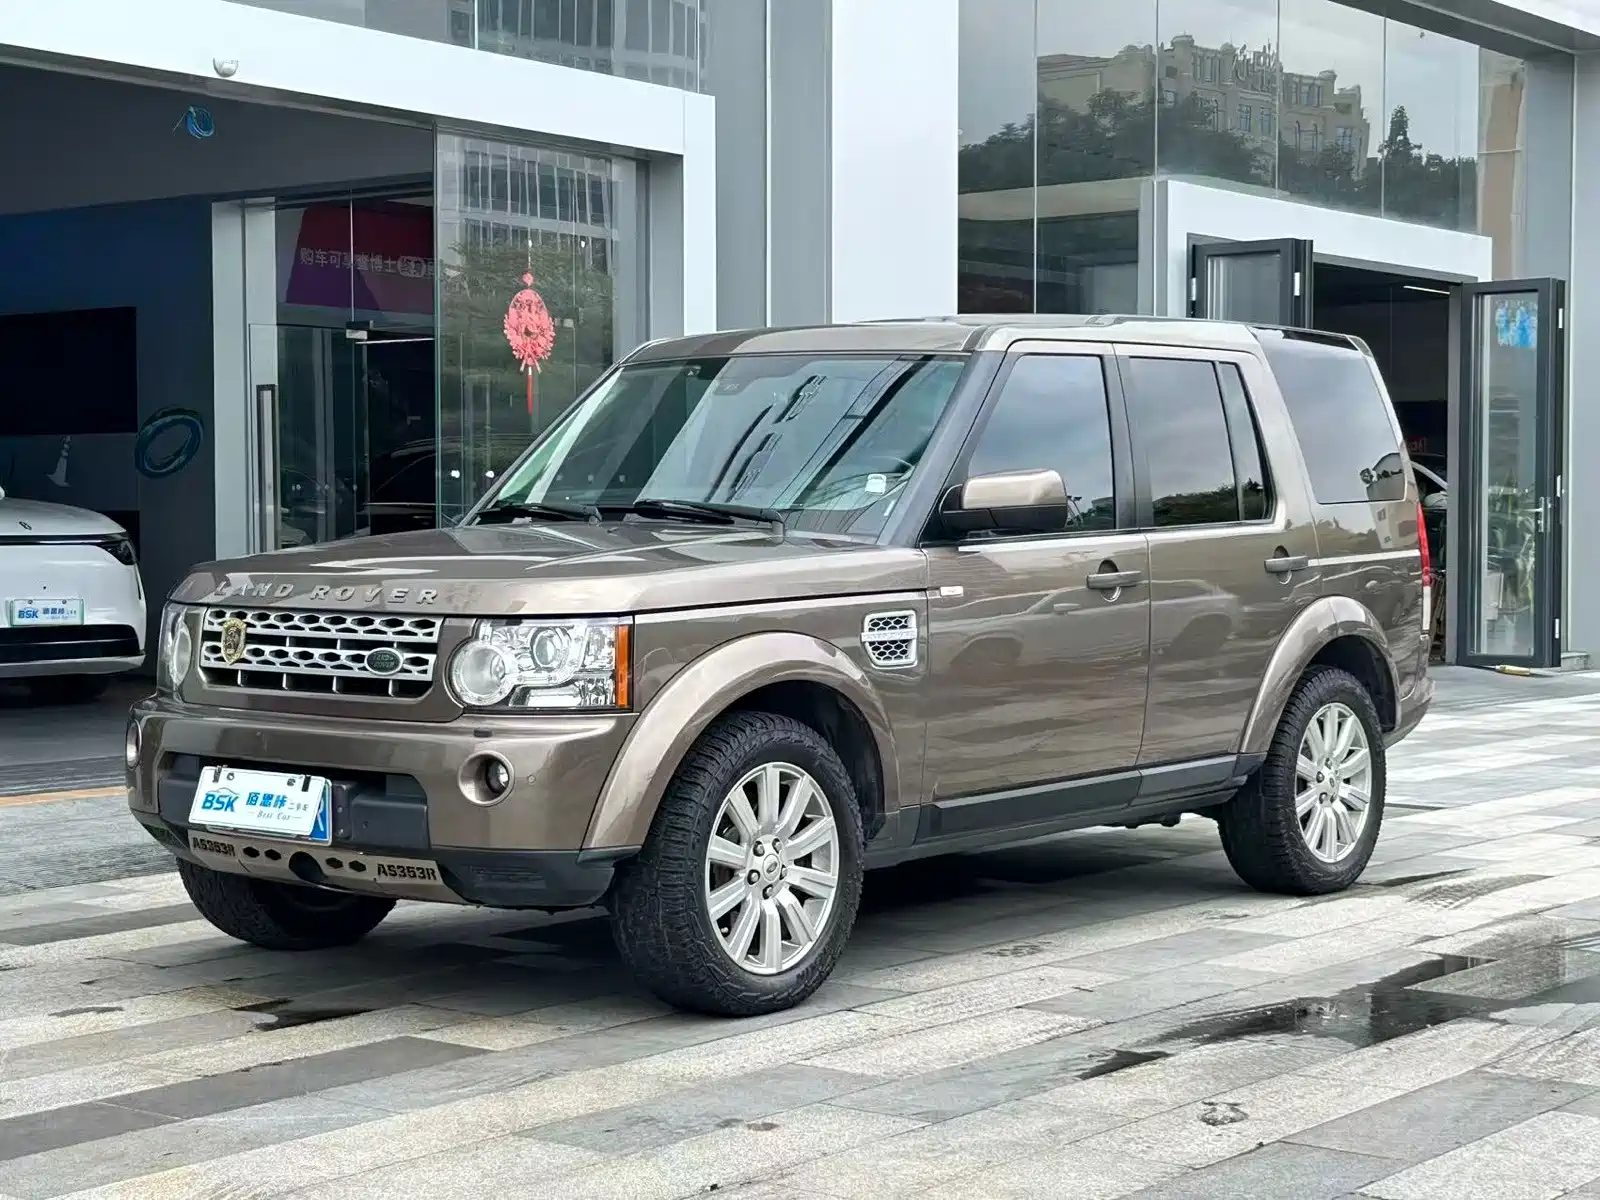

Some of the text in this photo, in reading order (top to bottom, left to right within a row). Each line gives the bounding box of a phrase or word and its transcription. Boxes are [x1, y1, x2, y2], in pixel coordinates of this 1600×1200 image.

[213, 580, 439, 605] LAND ROVER
[17, 608, 39, 619] BSK
[201, 792, 239, 813] BSK
[192, 836, 236, 857] AS353R
[377, 863, 437, 881] AS353R
